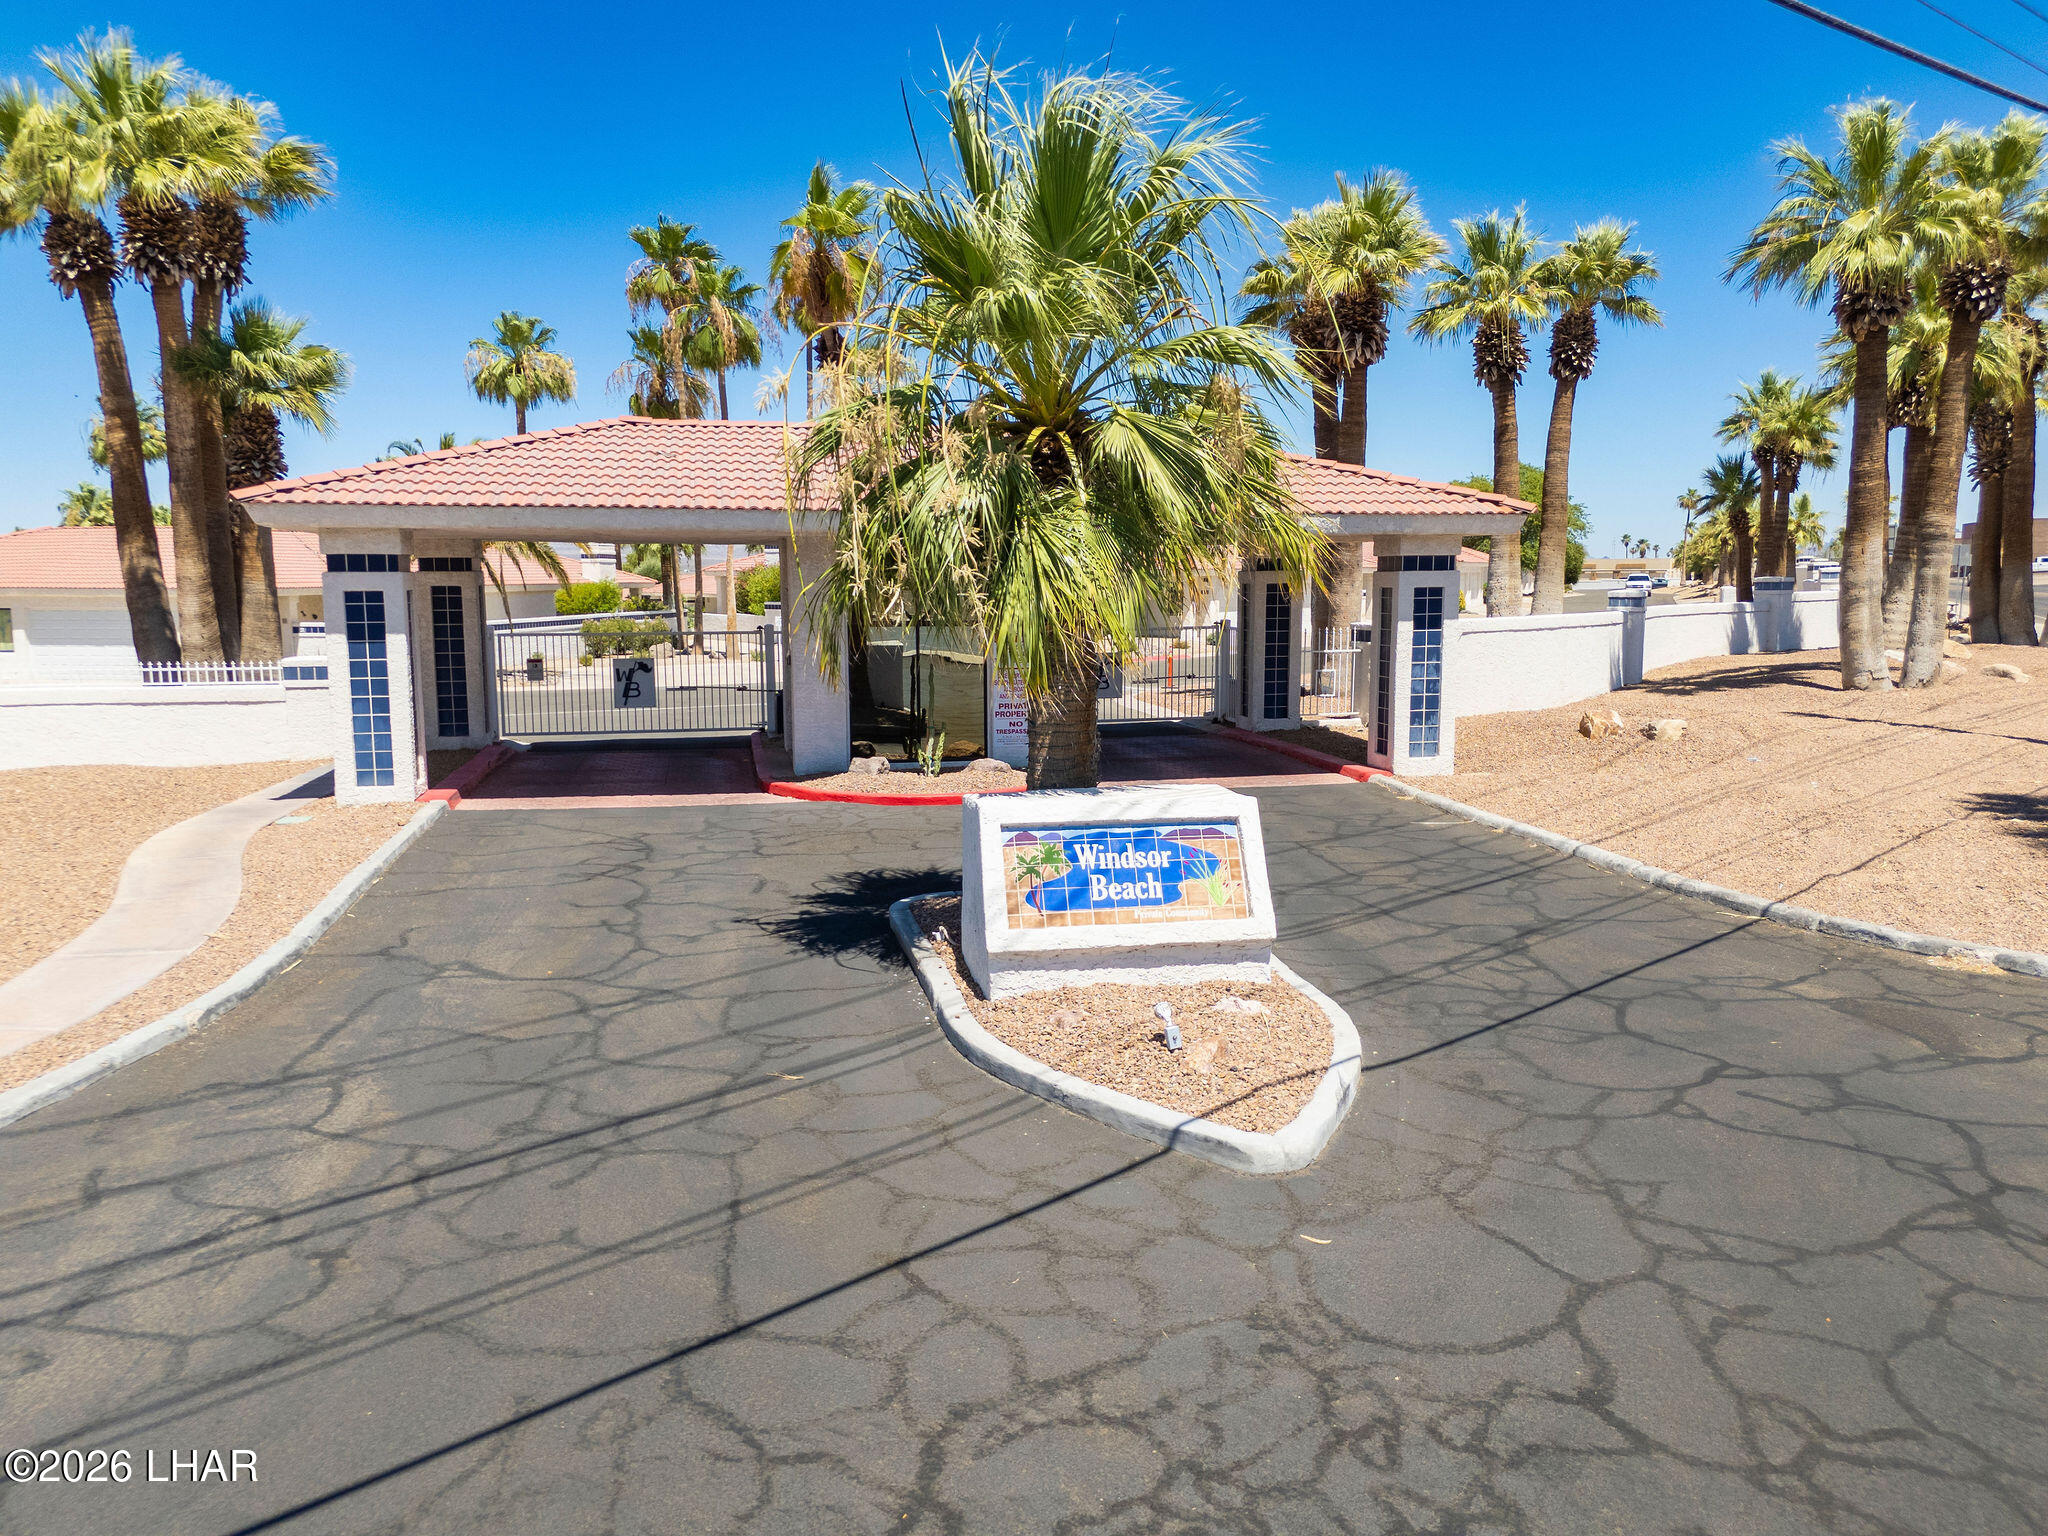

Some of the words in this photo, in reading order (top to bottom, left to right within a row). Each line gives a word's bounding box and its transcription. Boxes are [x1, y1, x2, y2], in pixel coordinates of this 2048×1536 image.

[615, 668, 634, 682] W
[623, 682, 641, 697] B
[1073, 843, 1171, 870] Windsor
[1090, 872, 1163, 901] Beach
